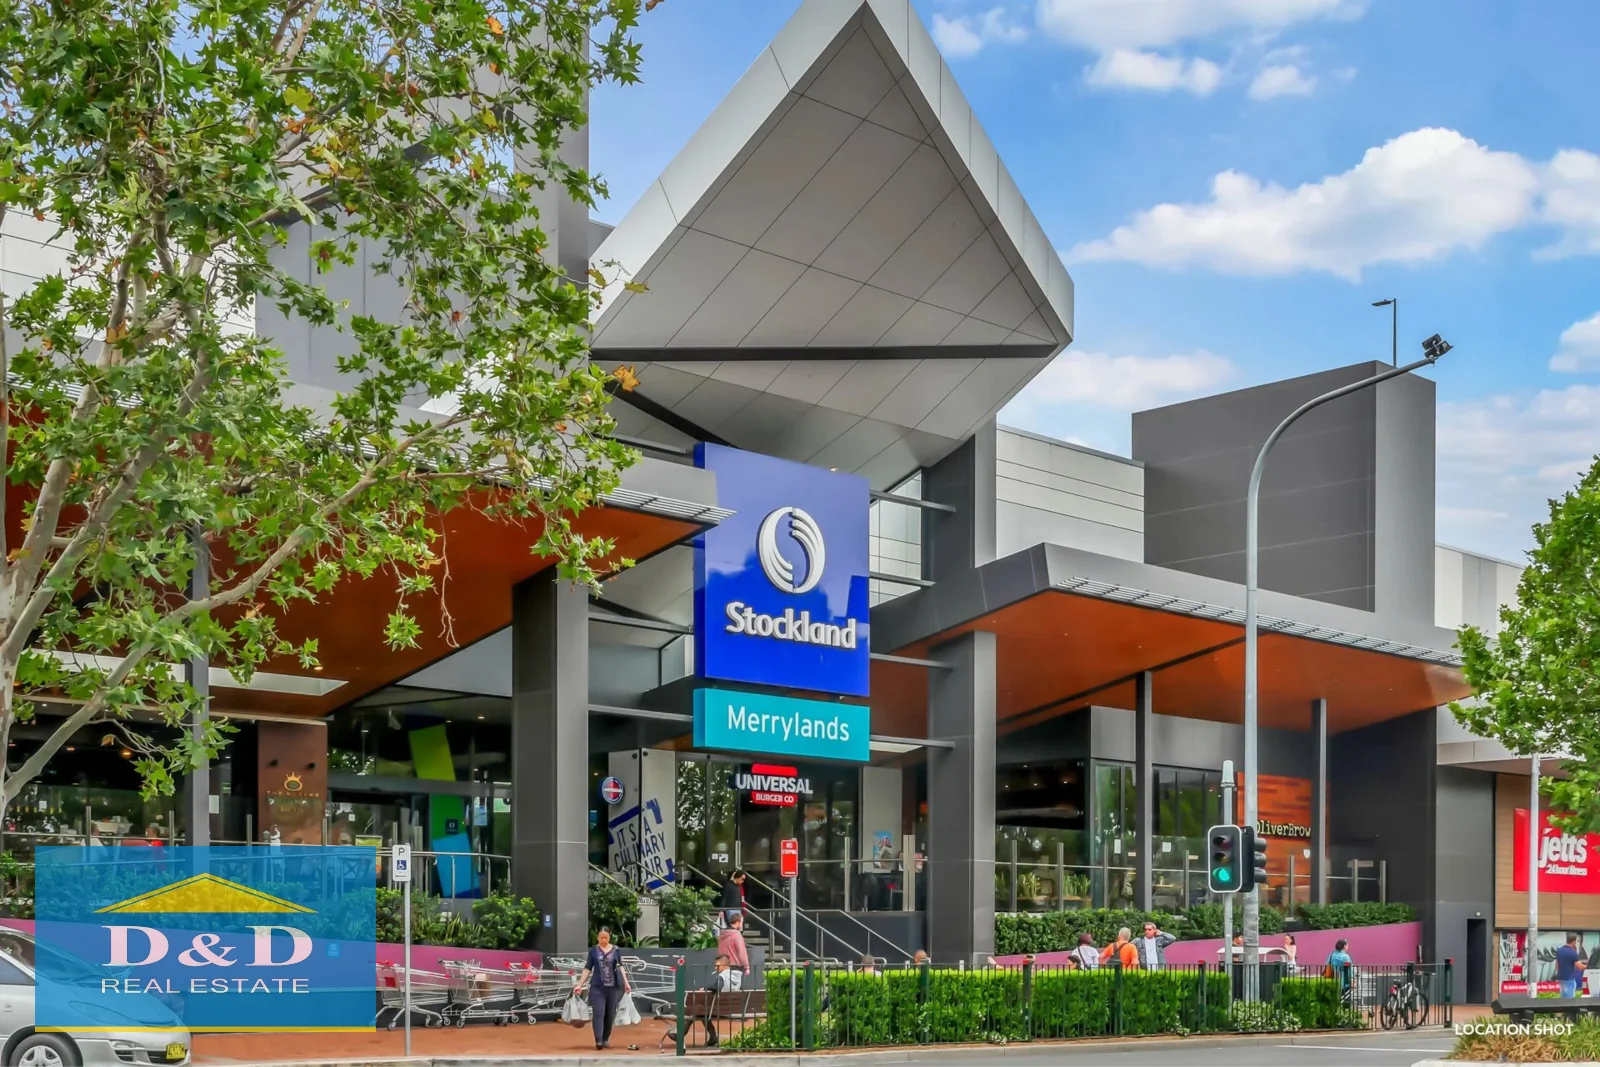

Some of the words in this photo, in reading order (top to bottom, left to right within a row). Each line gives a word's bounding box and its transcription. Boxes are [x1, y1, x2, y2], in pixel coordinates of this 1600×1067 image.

[726, 601, 857, 649] Stockland
[727, 704, 850, 741] Merrylands
[735, 773, 814, 795] UNIVERSAL
[756, 793, 782, 802] BURGER
[784, 795, 794, 803] CO
[616, 823, 637, 850] IT'S
[643, 816, 653, 837] A
[1538, 828, 1588, 869] jetts
[398, 847, 406, 857] P
[613, 831, 667, 872] CULINARY
